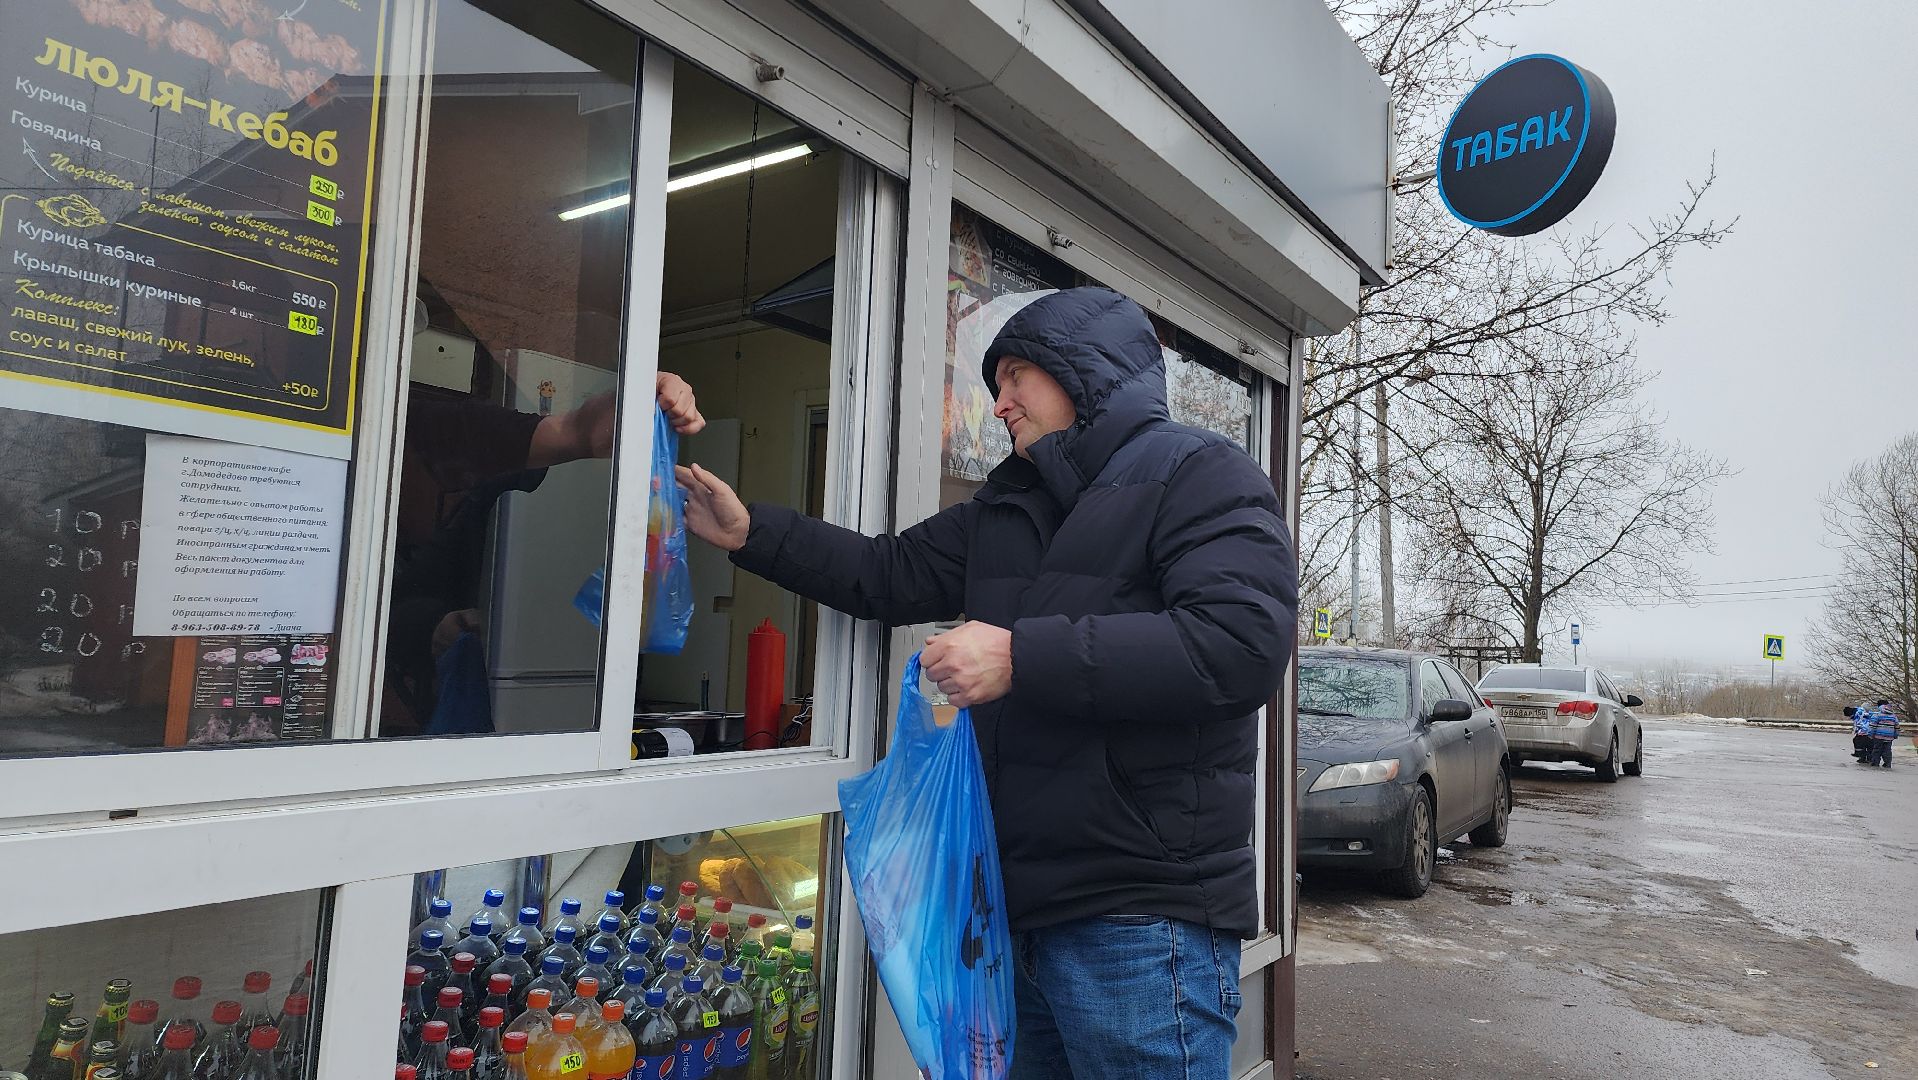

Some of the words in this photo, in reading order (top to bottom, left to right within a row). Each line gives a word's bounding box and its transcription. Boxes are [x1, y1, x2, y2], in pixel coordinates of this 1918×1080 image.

[15, 76, 87, 113] Курица
[11, 110, 102, 151] Говядина
[1451, 105, 1573, 171] ТАБАК
[51, 152, 135, 192] Подаётся
[140, 187, 149, 195] с
[235, 212, 289, 237] свежим
[312, 205, 330, 221] 300
[17, 219, 89, 250] Курица
[93, 242, 156, 268] табака
[209, 221, 259, 242] соусом
[264, 237, 274, 247] и
[278, 241, 339, 265] салатом
[13, 250, 120, 289] Крылышки
[125, 280, 202, 307] куриные
[15, 278, 120, 316] Комплекс:
[229, 307, 238, 316] 4
[239, 310, 255, 320] шт
[294, 315, 316, 331] 180
[10, 306, 80, 332] лаваш,
[85, 320, 153, 344] свежий
[156, 337, 192, 355] лук,
[195, 344, 256, 368] зелень,
[9, 330, 54, 350] соус
[57, 339, 70, 351] и
[74, 343, 127, 362] салат
[192, 458, 267, 473] корпоративное
[267, 465, 291, 475] кафе
[249, 476, 301, 487] требуются
[179, 494, 242, 507] Желательно
[250, 502, 287, 510] опытом
[288, 504, 324, 513] работы
[186, 509, 215, 520] сфере
[216, 512, 287, 524] общественного
[176, 539, 247, 550] Иностранным
[247, 542, 302, 553] гражданам
[175, 552, 198, 562] Весь
[199, 554, 230, 563] пакет
[230, 553, 288, 566] документов
[288, 558, 305, 566] для
[174, 566, 236, 575] оформления
[172, 594, 186, 602] По
[213, 596, 259, 604] вопросам
[172, 608, 234, 618] Обращаться
[564, 1056, 581, 1069] 150
